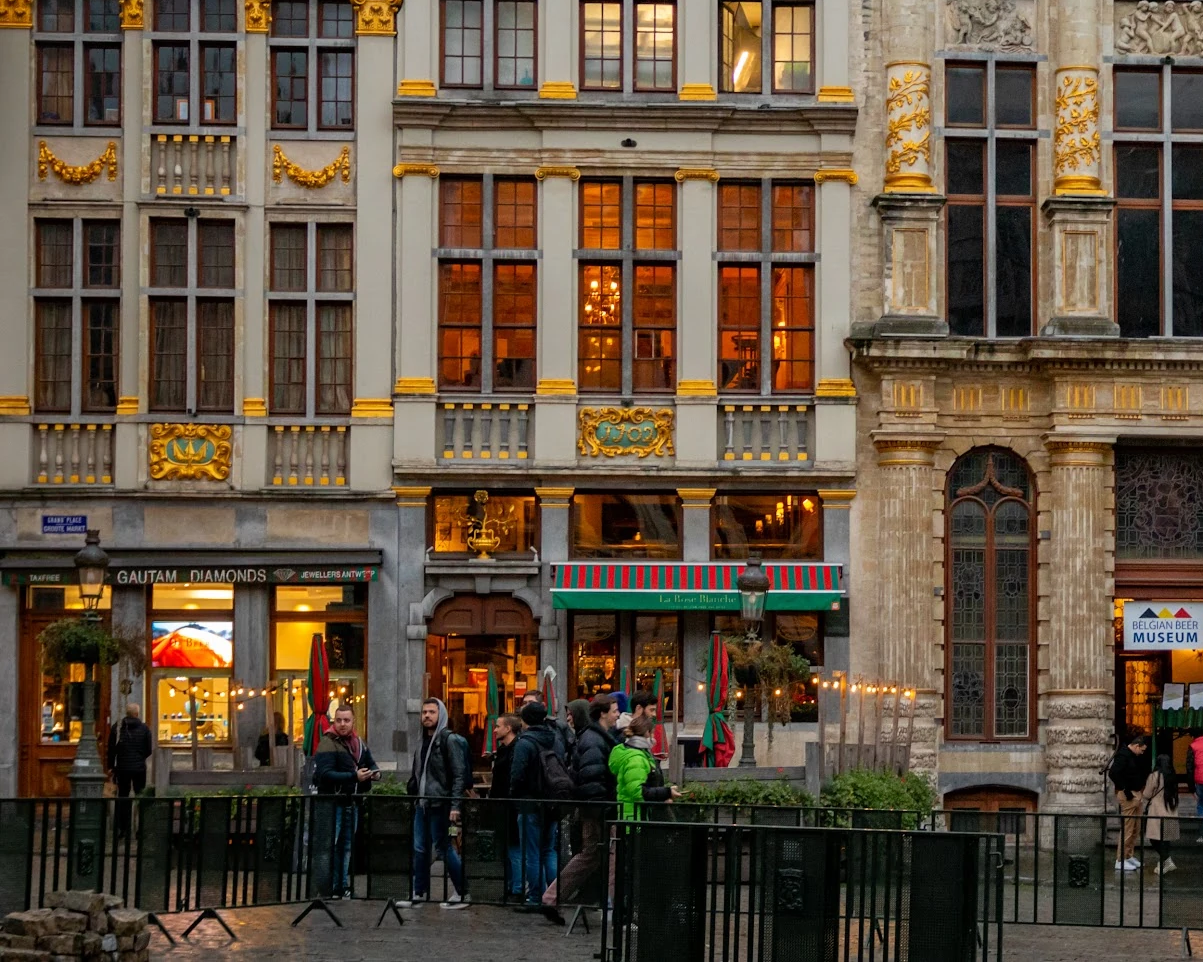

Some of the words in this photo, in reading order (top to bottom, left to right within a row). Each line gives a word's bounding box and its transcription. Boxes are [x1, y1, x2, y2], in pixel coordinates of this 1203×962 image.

[29, 574, 60, 582] TAXFREE
[117, 570, 177, 584] GAUTAM
[190, 569, 267, 583] DIAMONDS
[301, 570, 341, 579] JEWELLERS
[1132, 620, 1173, 630] BELGIAN
[1175, 621, 1199, 630] BEER
[1133, 632, 1198, 643] MUSEUM
